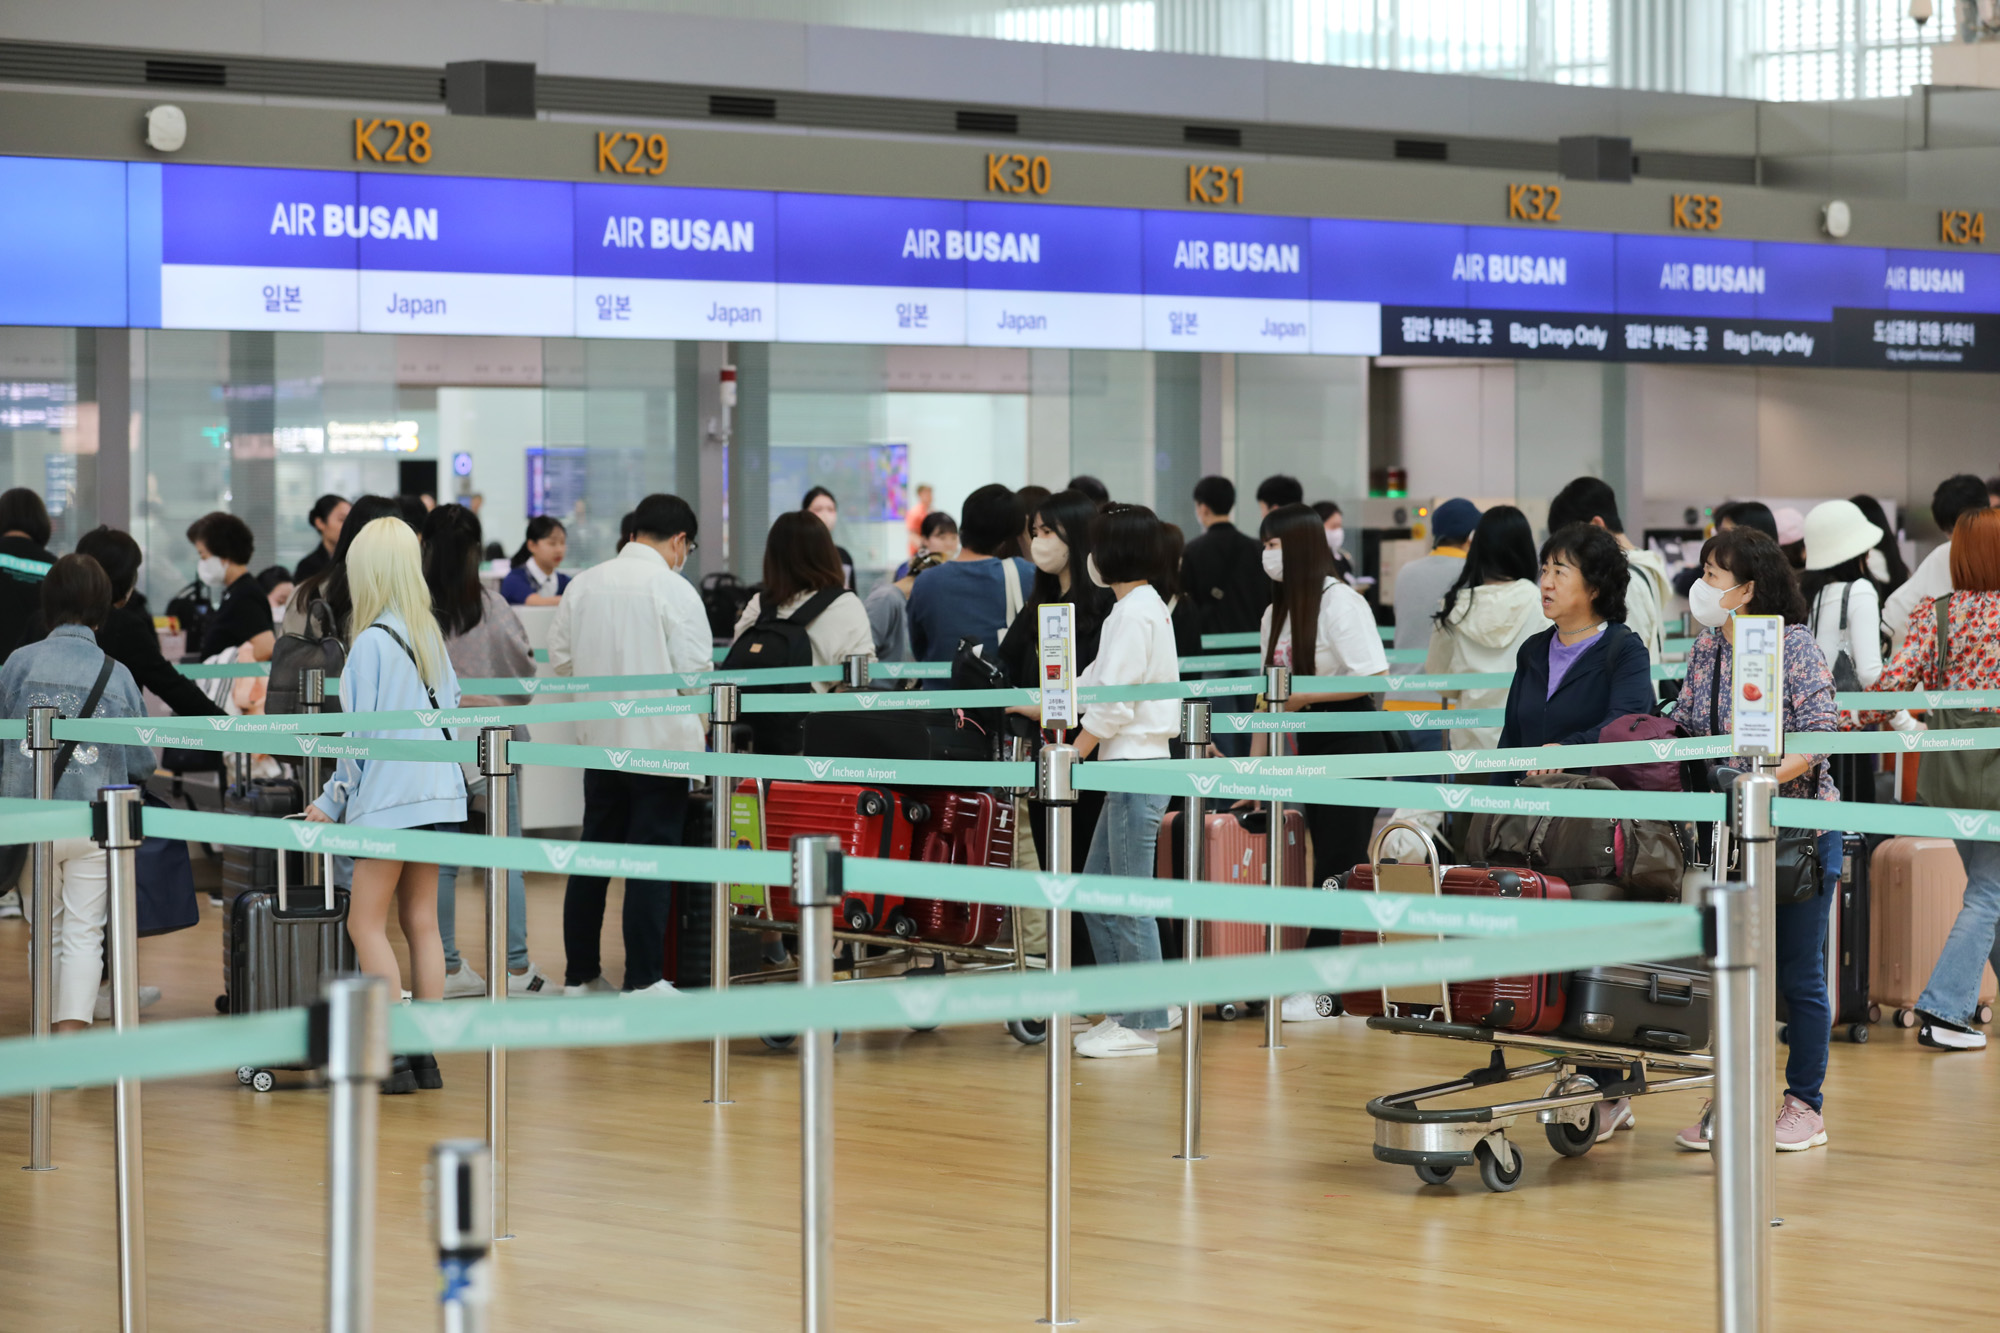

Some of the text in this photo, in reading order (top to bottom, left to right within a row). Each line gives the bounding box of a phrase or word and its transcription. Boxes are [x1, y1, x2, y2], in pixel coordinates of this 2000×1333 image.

[355, 118, 432, 163] K28
[598, 131, 669, 175] K29
[988, 154, 1051, 194] K30
[1189, 165, 1244, 204] K31
[1509, 184, 1562, 220] K32
[1673, 195, 1722, 230] K33
[270, 202, 438, 241] AIR BUSAN
[1942, 210, 1986, 244] K34
[602, 216, 754, 252] AIR BUSAN
[902, 228, 1040, 263] AIR BUSAN
[1174, 240, 1299, 273] AIR BUSAN
[1452, 253, 1566, 285] AIR BUSAN
[1660, 263, 1765, 294] AIR BUSAN
[1885, 266, 1964, 293] AIR BUSAN
[263, 285, 302, 313] 일본
[387, 293, 447, 319] Japan
[596, 294, 631, 321] 일본
[707, 301, 761, 327] Japan
[896, 303, 929, 328] 일본
[997, 310, 1047, 333] Japan
[1169, 311, 1198, 335] 일본
[1261, 318, 1306, 340] Japan
[1510, 323, 1608, 350] Bag Drop Only
[1723, 329, 1814, 357] Bag Drop Only
[540, 683, 590, 691] Incheon Airport
[1206, 684, 1253, 694] Incheon Airport
[1404, 680, 1448, 689] Incheon Airport
[634, 704, 691, 715] Incheon Airport
[877, 697, 930, 708] Incheon Airport
[1942, 697, 1985, 706] Incheon Airport
[235, 722, 299, 732] Incheon Airport
[440, 714, 500, 725] Incheon Airport
[1251, 720, 1306, 730] Incheon Airport
[1427, 717, 1479, 727] Incheon Airport
[155, 734, 203, 747] Incheon Airport
[317, 744, 369, 757] Incheon Airport
[1674, 745, 1732, 756] Incheon Airport
[1922, 737, 1975, 748] Incheon Airport
[630, 757, 690, 772] Incheon Airport
[832, 766, 896, 780] Incheon Airport
[1260, 765, 1326, 777] Incheon Airport
[1475, 757, 1537, 769] Incheon Airport
[1219, 783, 1293, 798] Incheon Airport
[1470, 796, 1550, 812] Incheon Airport
[321, 835, 397, 855] Incheon Airport
[574, 855, 658, 874] Incheon Airport
